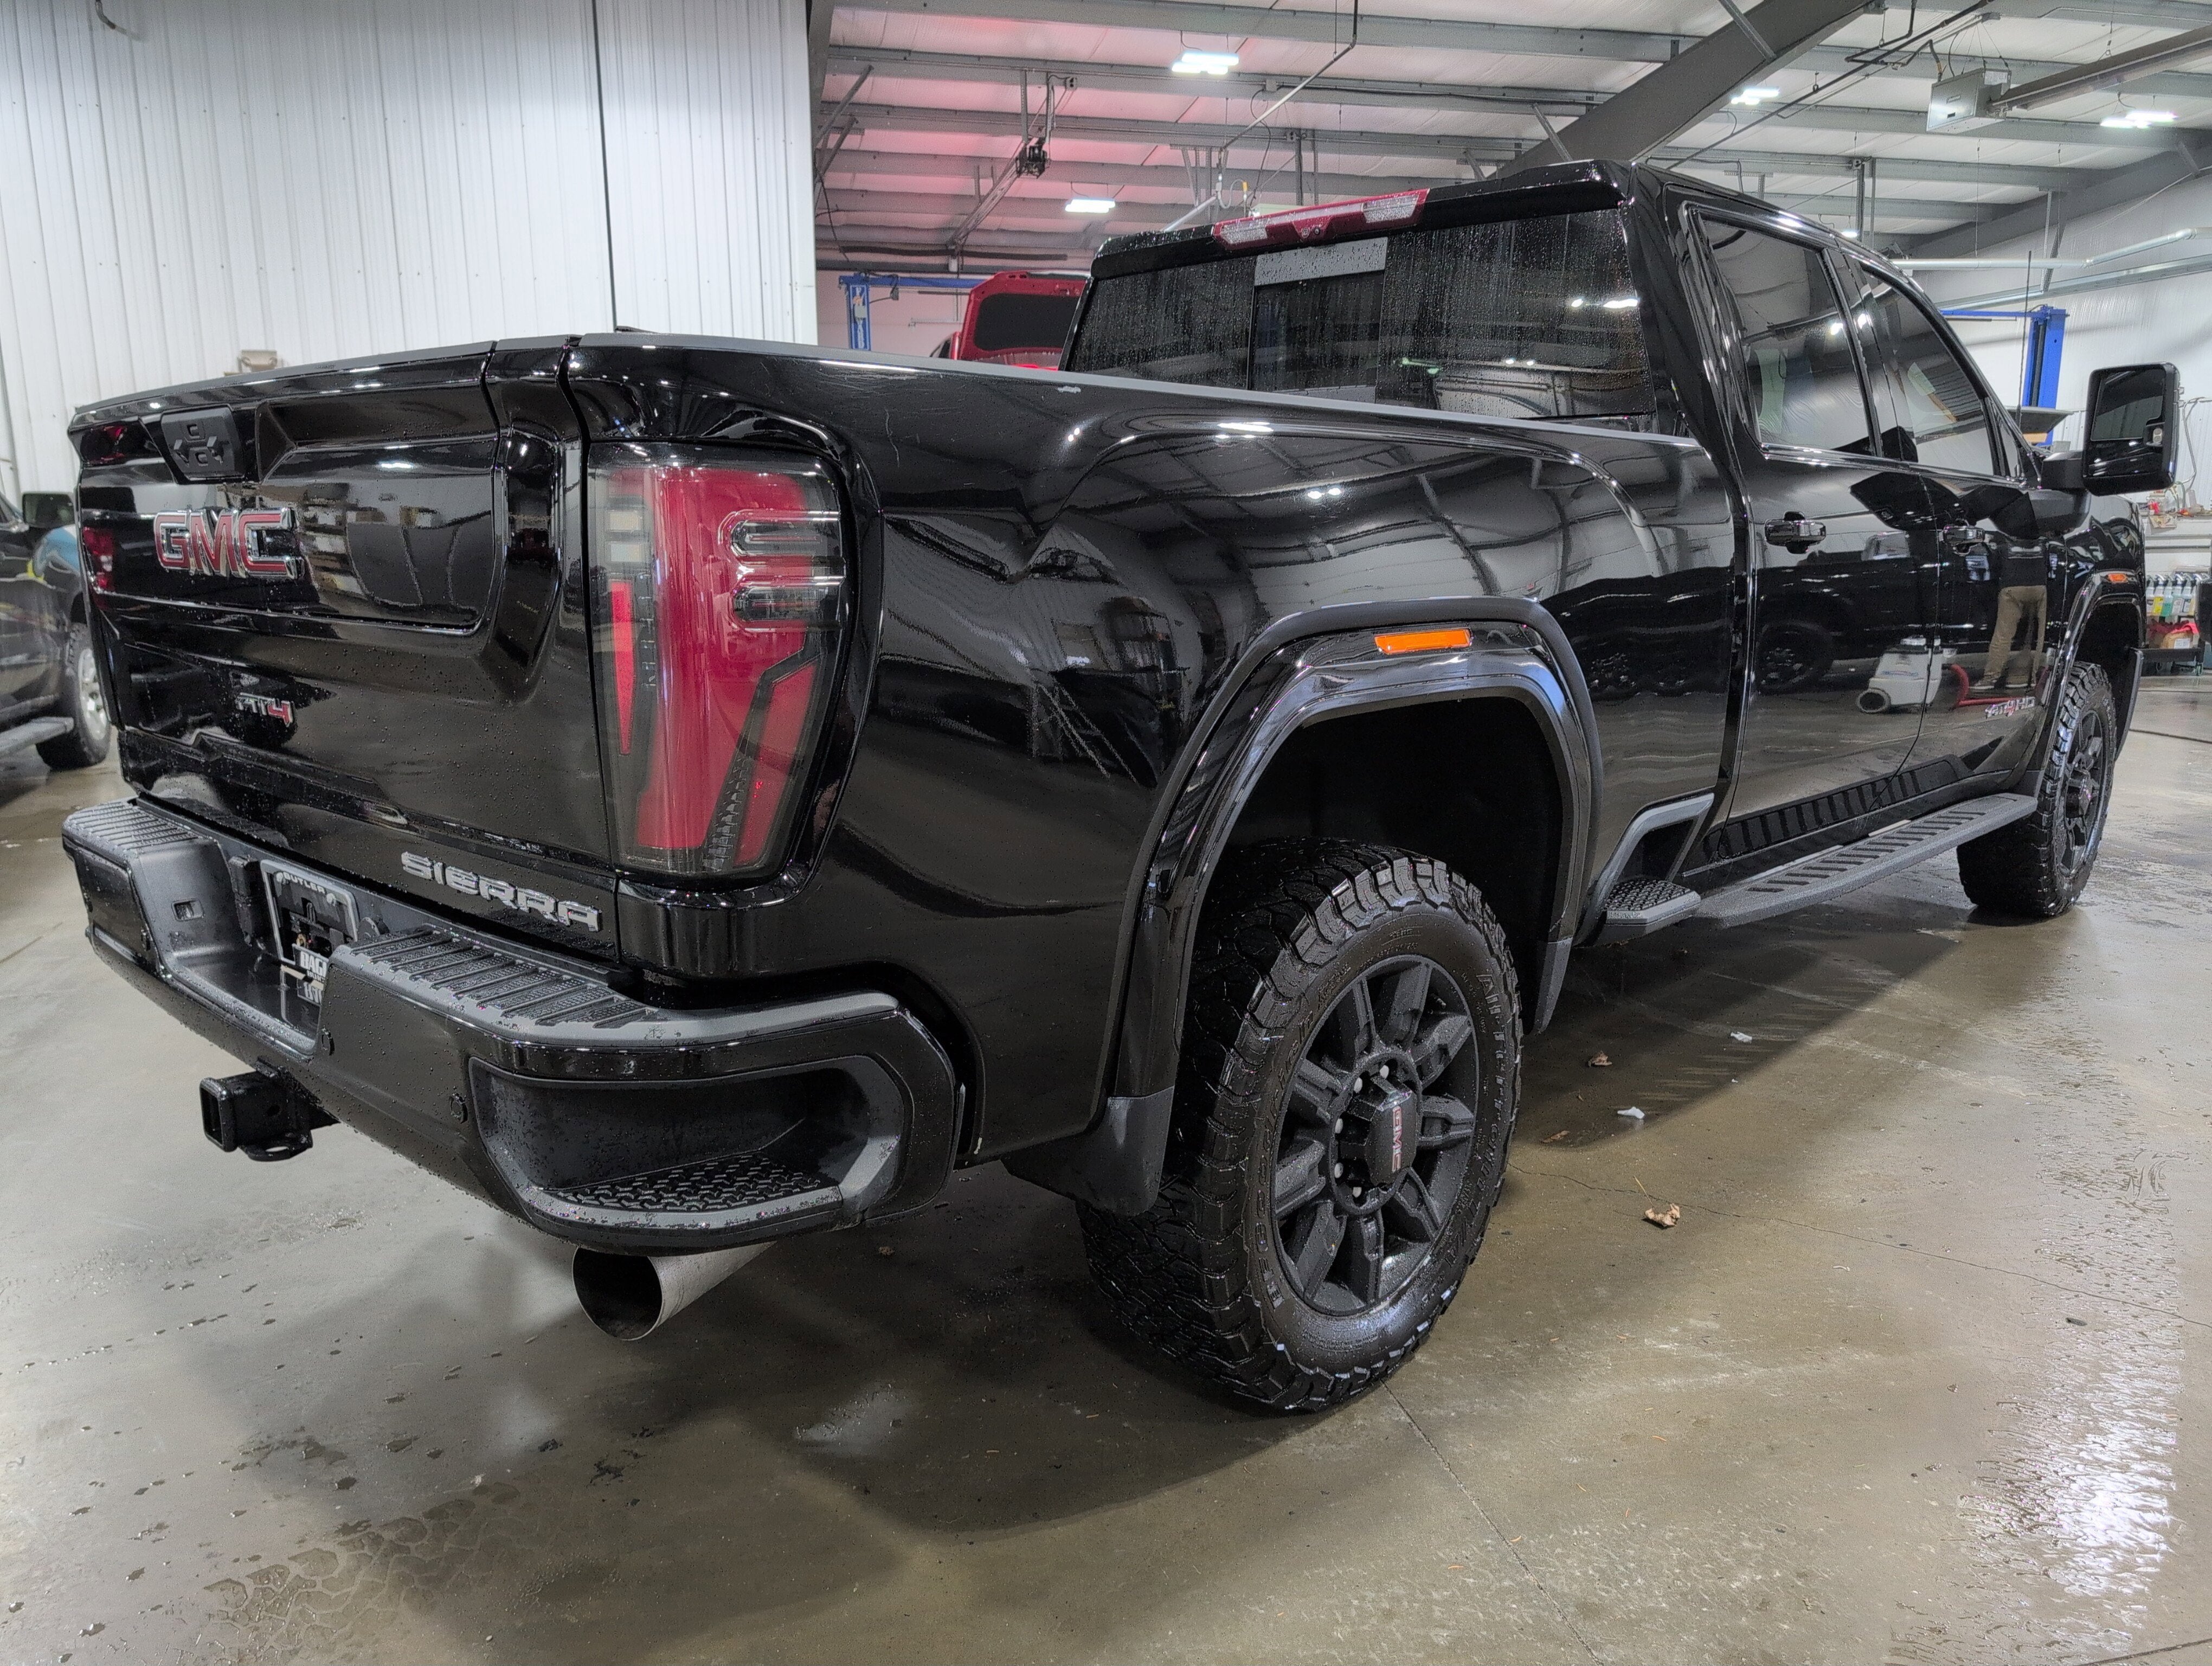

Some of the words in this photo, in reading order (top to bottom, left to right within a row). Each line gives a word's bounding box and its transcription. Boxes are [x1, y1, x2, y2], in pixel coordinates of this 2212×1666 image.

[153, 507, 302, 579] GMC
[235, 692, 293, 727] AT4
[283, 871, 326, 894] BUTLER
[401, 851, 600, 932] SIERRA
[1392, 1106, 1402, 1173] GMC
